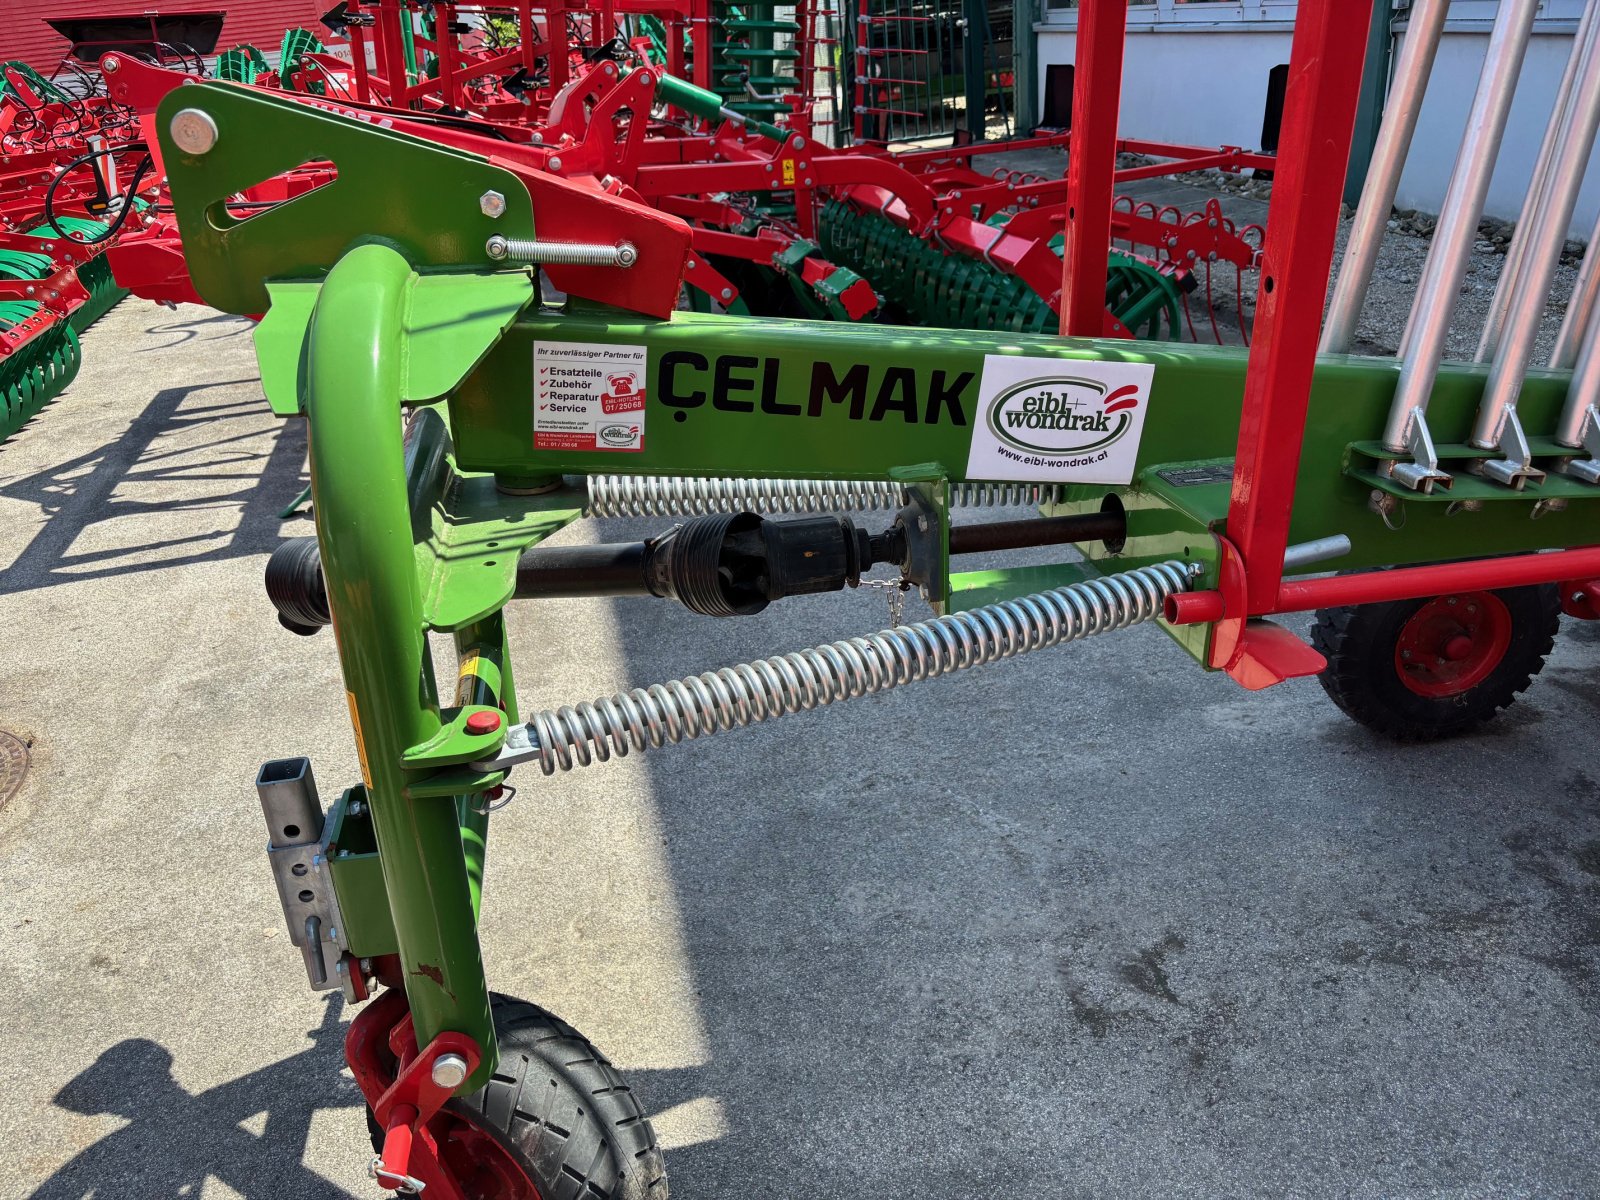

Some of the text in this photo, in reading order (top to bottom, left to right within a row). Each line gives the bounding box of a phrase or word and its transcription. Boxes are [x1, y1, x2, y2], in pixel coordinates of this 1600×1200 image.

[550, 349, 602, 359] zuverlässiger
[549, 367, 602, 378] Ersatzteile
[549, 379, 592, 389] Zubehör
[549, 391, 599, 402] Reparatur
[549, 404, 587, 413] Service
[1005, 407, 1111, 432] wondrak
[997, 446, 1108, 468] www.eibl-wondrak.at
